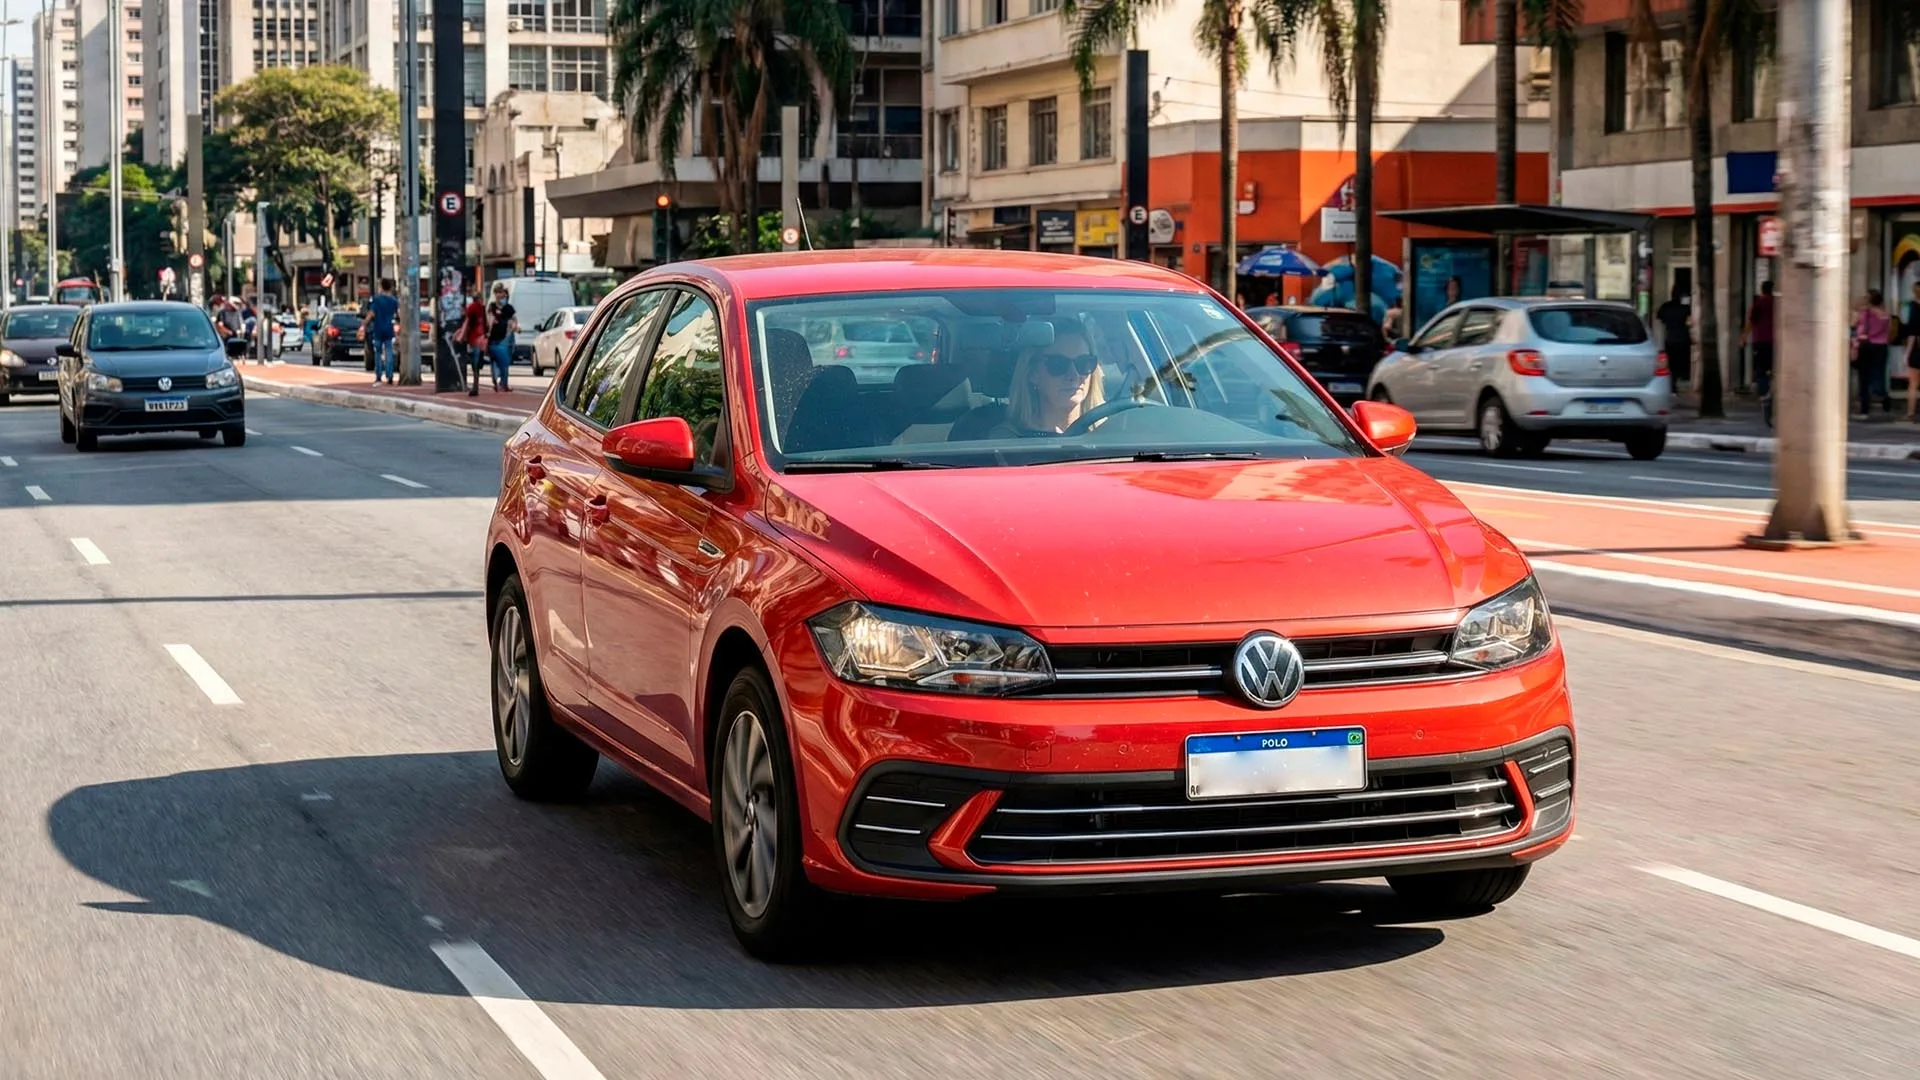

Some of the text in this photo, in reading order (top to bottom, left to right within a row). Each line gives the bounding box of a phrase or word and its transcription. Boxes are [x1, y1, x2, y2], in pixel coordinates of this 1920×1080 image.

[446, 196, 456, 210] E
[1135, 209, 1143, 220] E
[1236, 634, 1303, 706] VW
[1261, 737, 1289, 748] POLO
